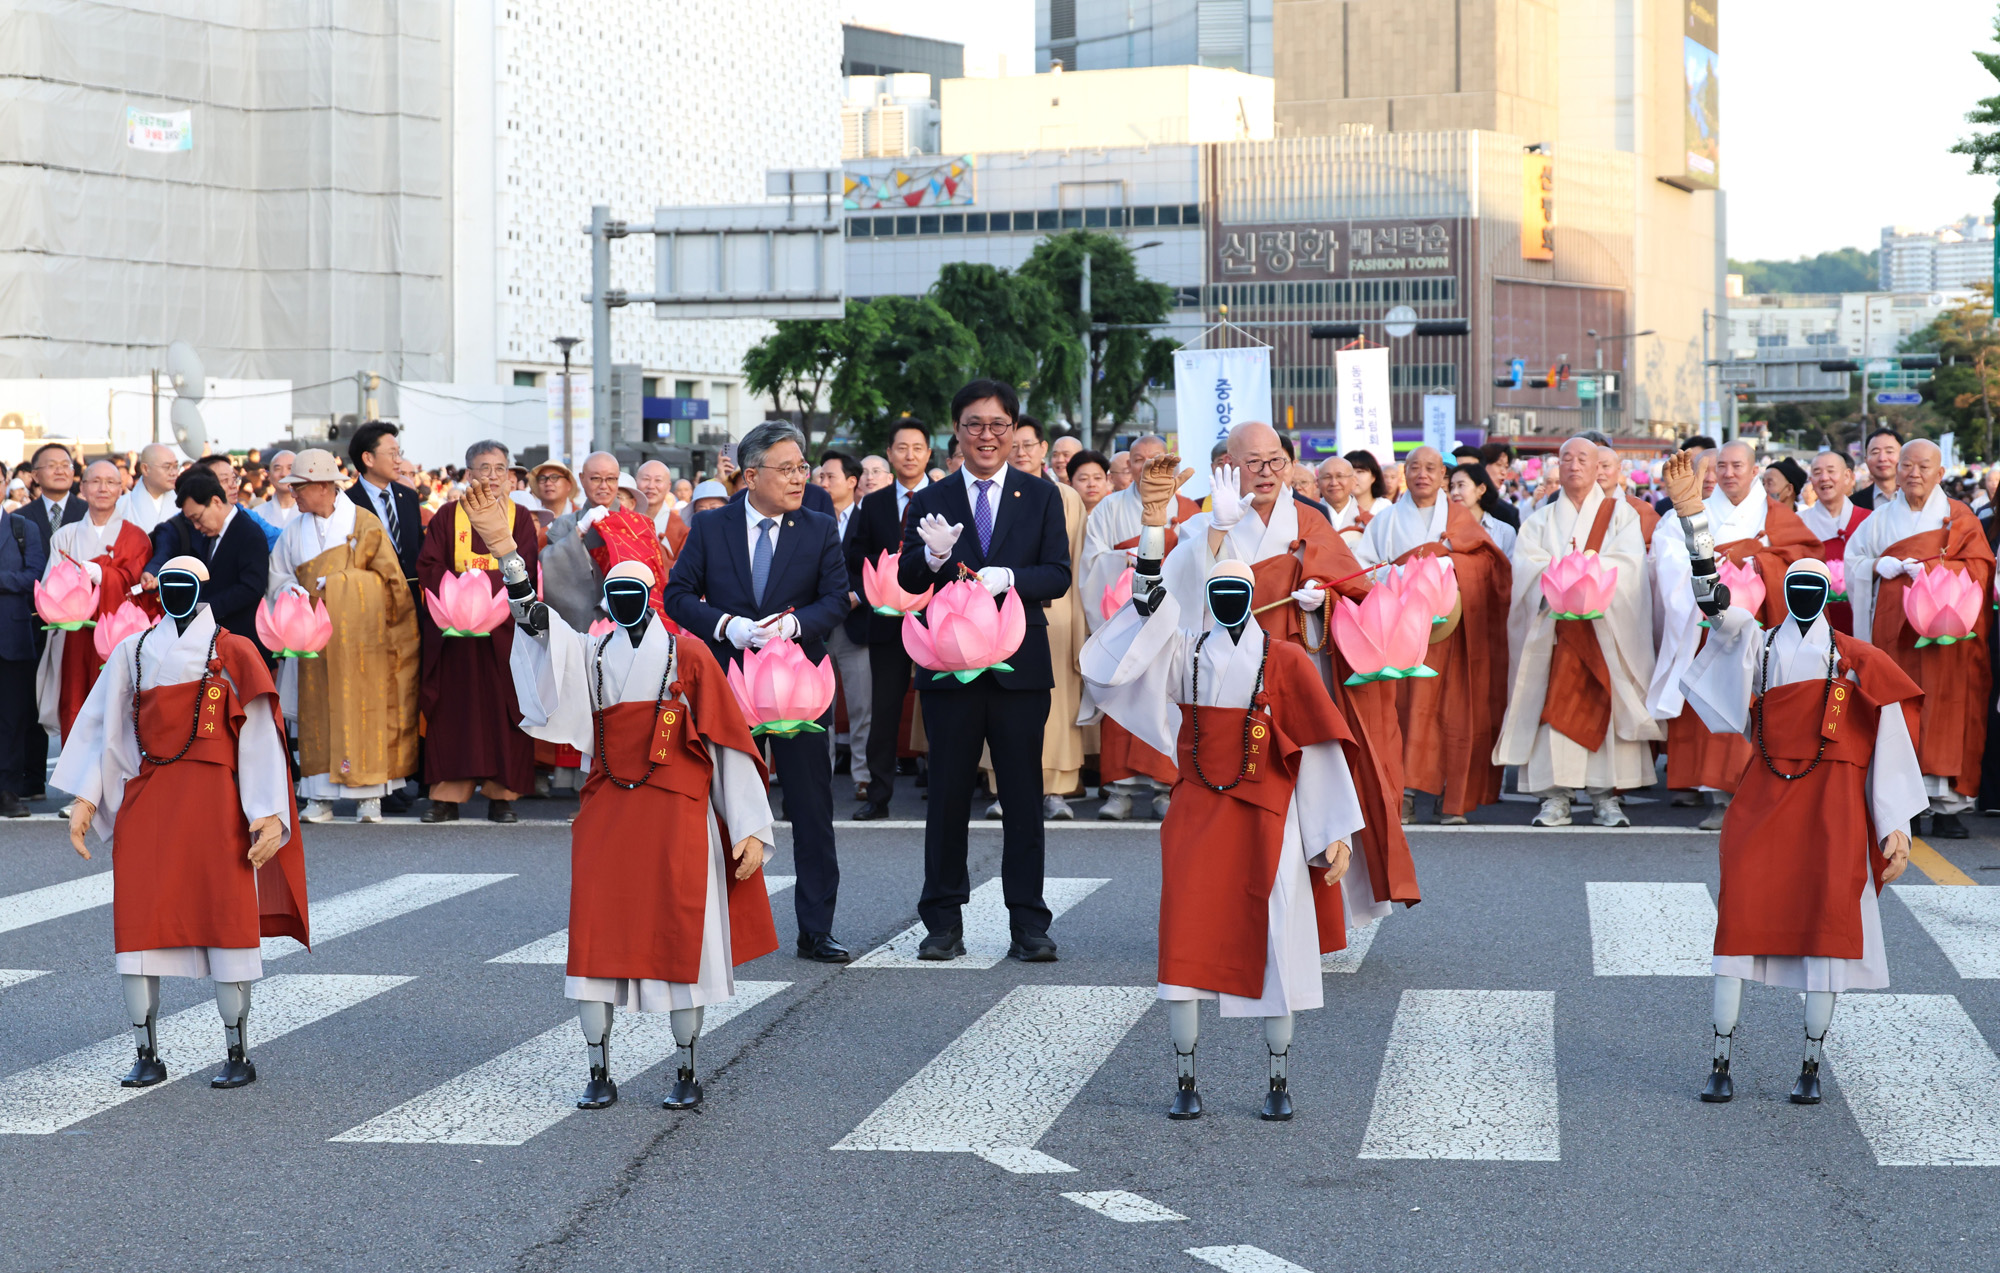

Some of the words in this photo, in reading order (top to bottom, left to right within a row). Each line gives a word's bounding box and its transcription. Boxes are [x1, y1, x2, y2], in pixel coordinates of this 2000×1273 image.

[1219, 228, 1339, 275] 신평화
[1351, 224, 1450, 255] 패션타운
[1350, 257, 1405, 272] FASHION
[1409, 256, 1449, 269] TOWN
[1352, 365, 1364, 430] 동국대학교
[204, 703, 216, 733] 석자
[1828, 704, 1841, 734] 가비
[656, 729, 671, 760] 니사
[1247, 744, 1260, 774] 모희
